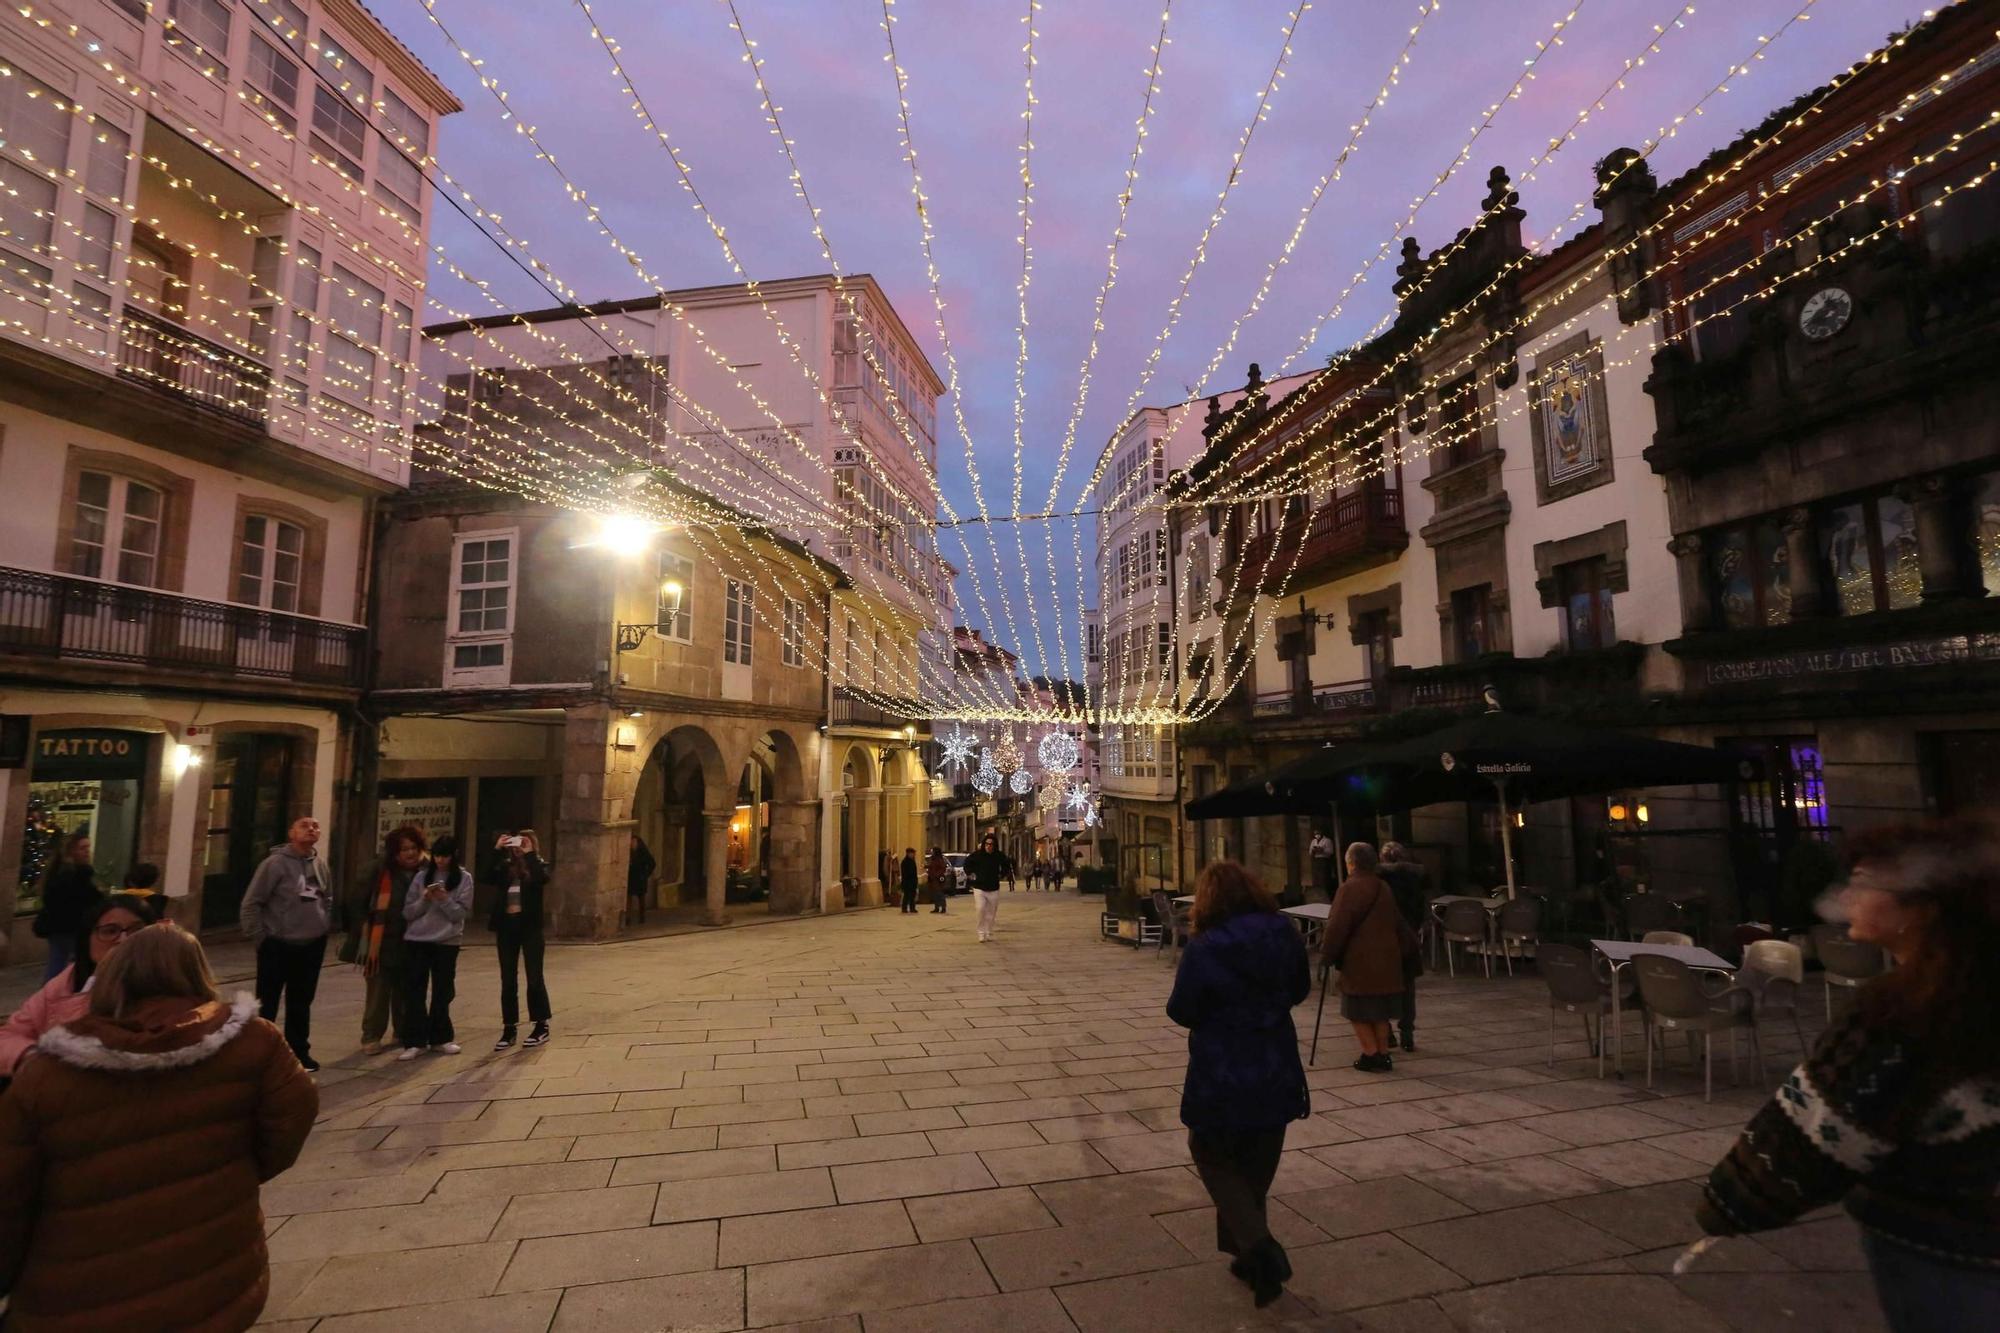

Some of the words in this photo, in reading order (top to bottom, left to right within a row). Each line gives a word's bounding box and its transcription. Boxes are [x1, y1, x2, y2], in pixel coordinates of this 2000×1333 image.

[39, 738, 129, 756] TATTOO
[1476, 763, 1504, 773] Estrella
[1505, 762, 1531, 773] Galicia
